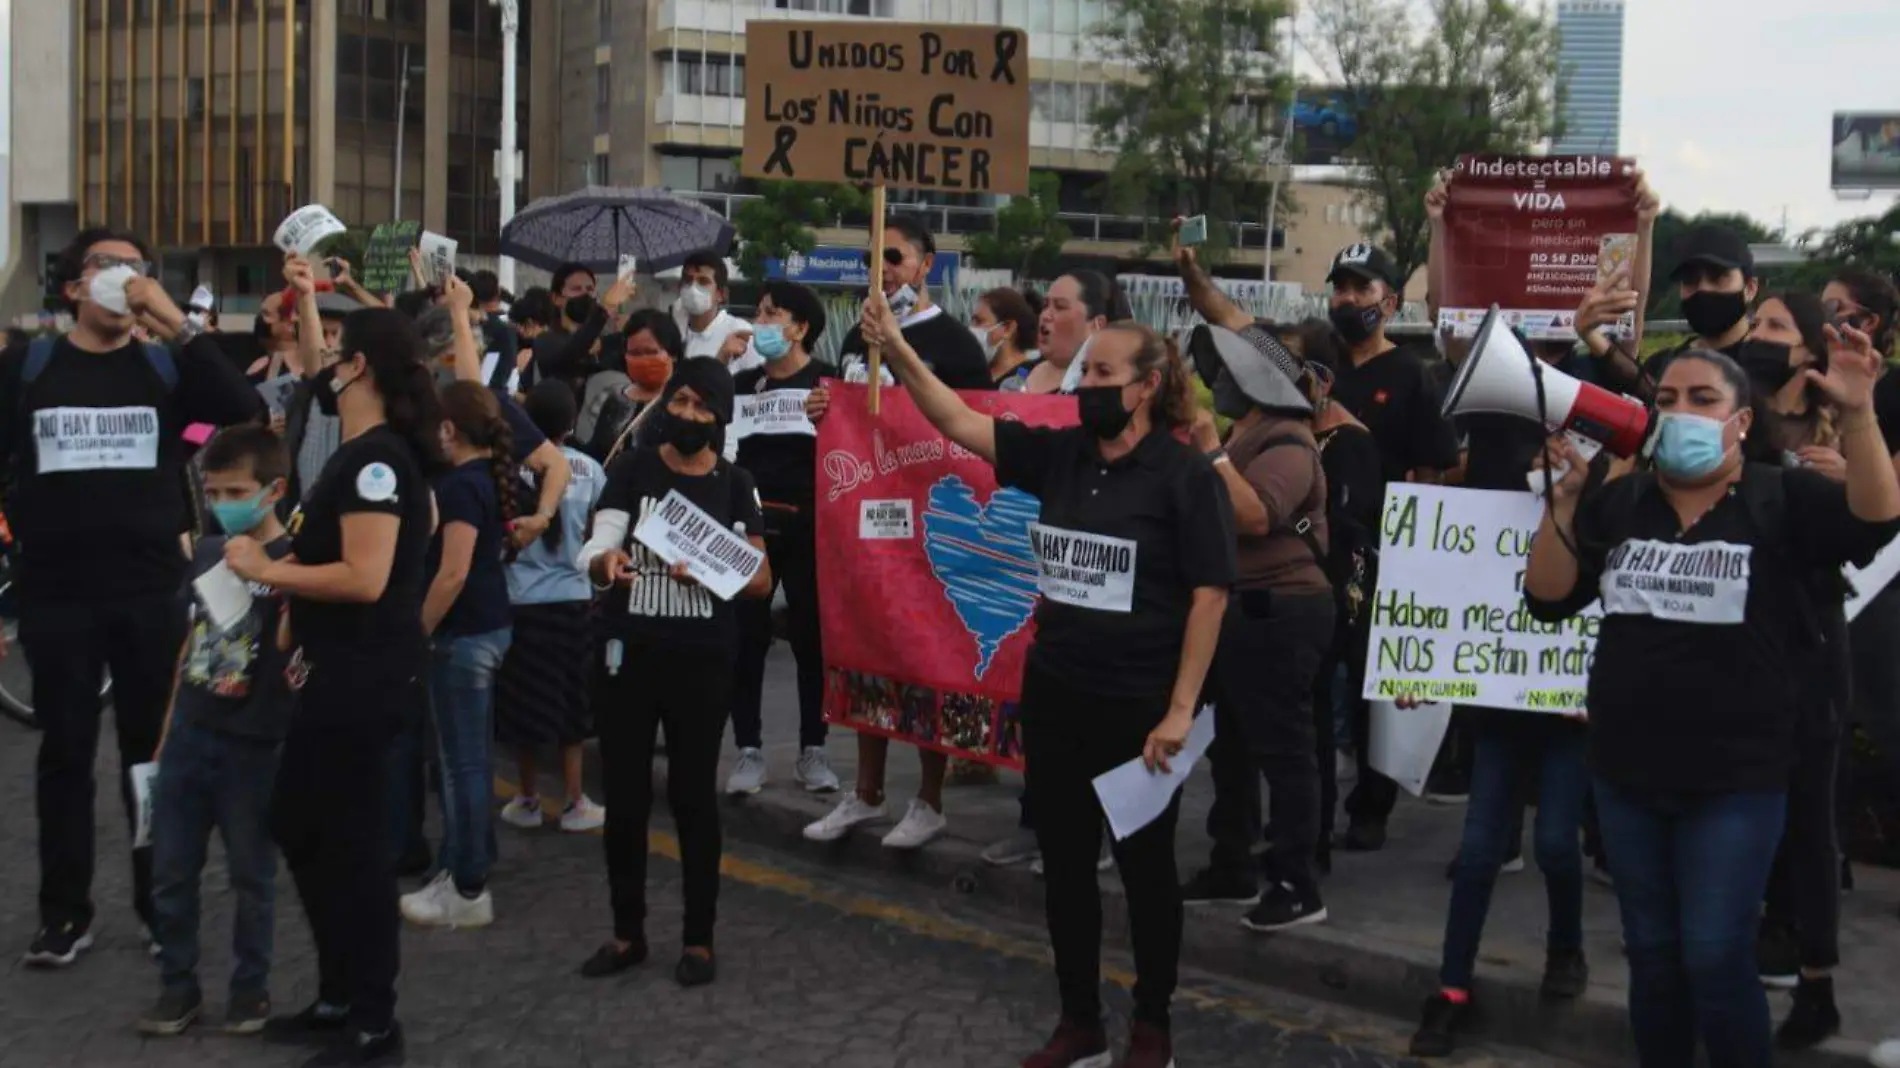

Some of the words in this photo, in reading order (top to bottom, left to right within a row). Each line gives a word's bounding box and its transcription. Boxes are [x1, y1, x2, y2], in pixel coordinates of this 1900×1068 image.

[764, 83, 818, 125] Los
[829, 88, 914, 132] Niños
[928, 94, 993, 138] Con
[844, 131, 990, 189] CÁNCER
[1469, 157, 1612, 176] Indetectable
[1512, 192, 1566, 211] VIDA
[1531, 218, 1563, 229] pero
[1568, 216, 1586, 227] sin
[809, 256, 858, 269] Nacional
[1530, 253, 1548, 263] no
[1551, 254, 1567, 263] se
[40, 414, 57, 439] NO
[62, 413, 91, 436] HAY
[96, 412, 154, 436] QUIMIO
[824, 450, 874, 502] De
[874, 429, 898, 475] la
[660, 498, 688, 526] NO
[679, 512, 716, 546] HAY
[706, 534, 759, 577] QUIMIO
[1432, 501, 1476, 553] los
[1043, 533, 1070, 563] HAY
[1071, 538, 1130, 574] QUIMIO
[1627, 547, 1669, 572] HAY
[1669, 550, 1744, 580] QUIMIO
[1667, 577, 1715, 597] MATANDO
[1374, 590, 1448, 630] Habra
[1378, 635, 1434, 673] NOS
[1453, 638, 1527, 674] estan
